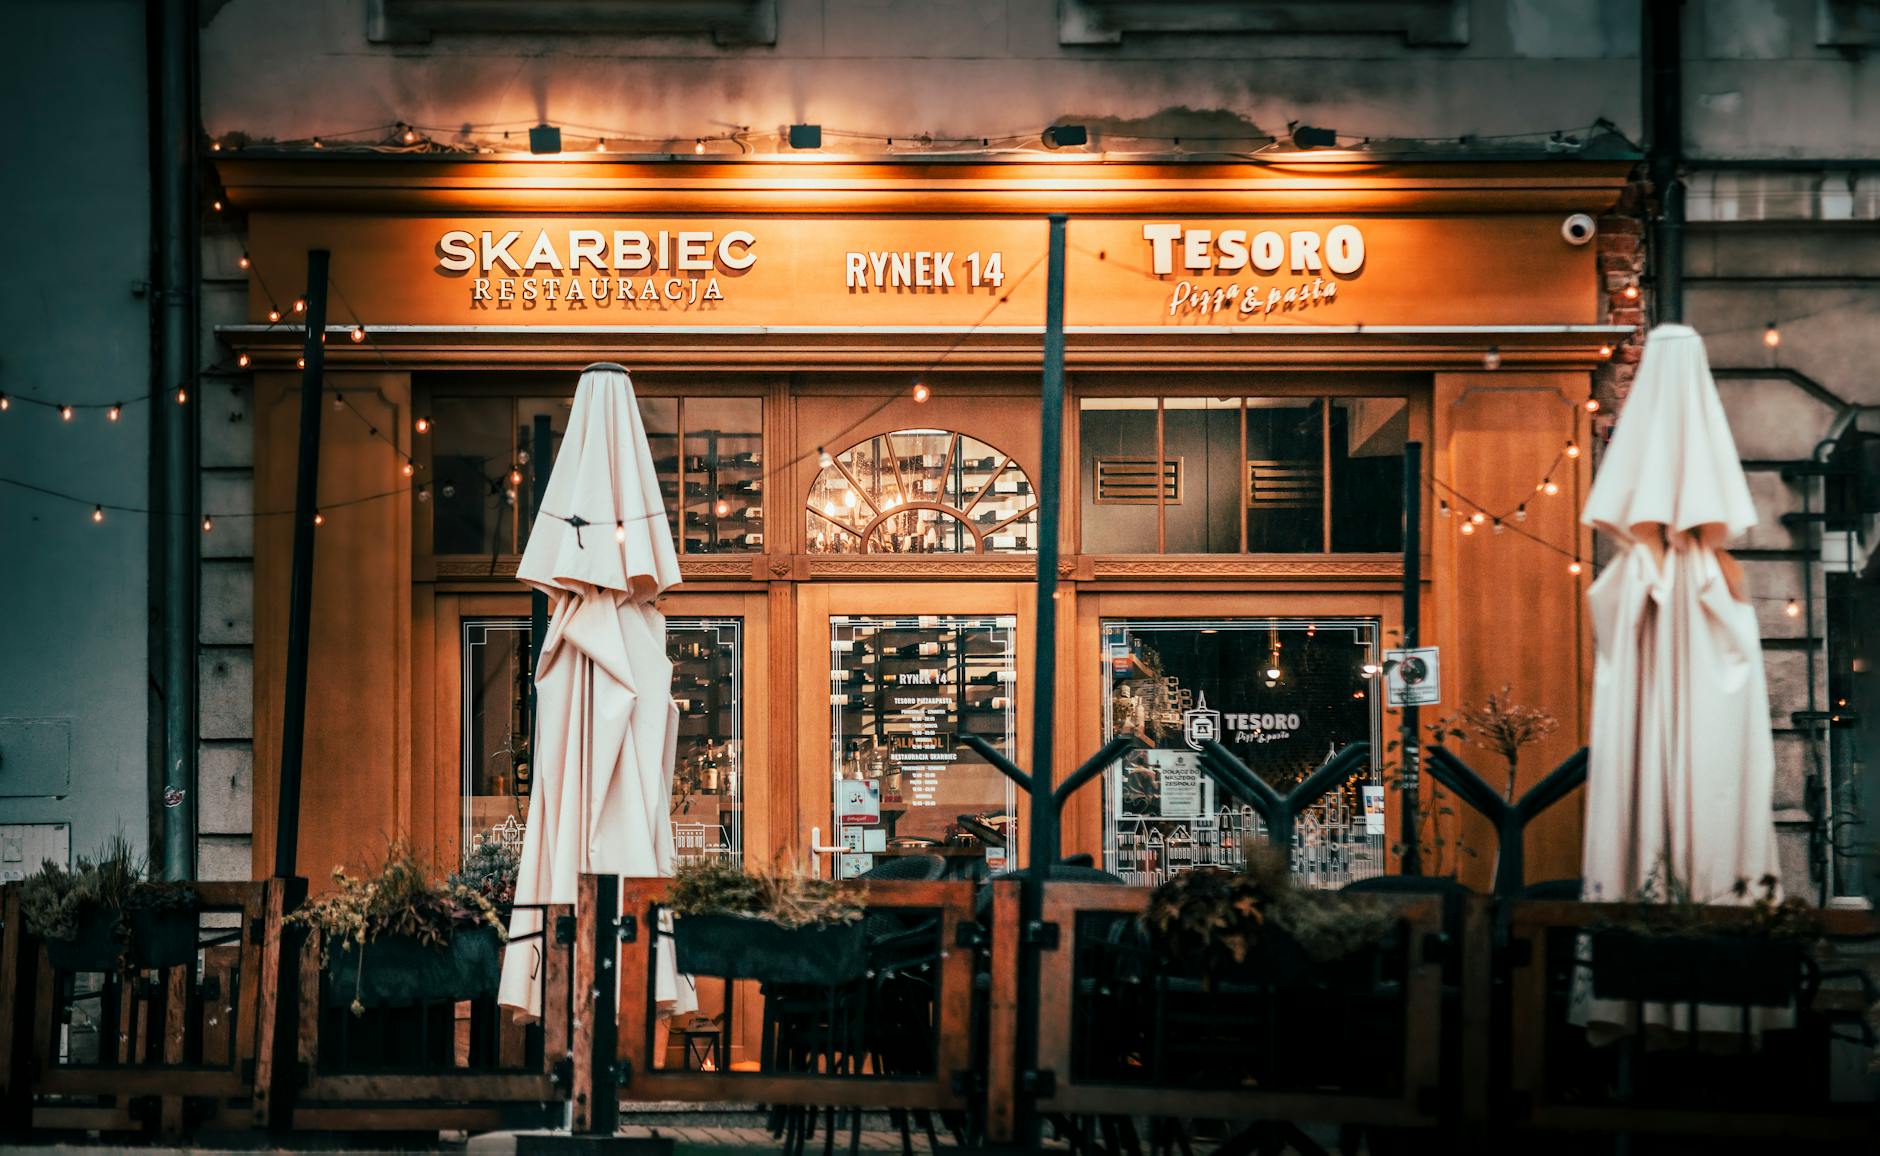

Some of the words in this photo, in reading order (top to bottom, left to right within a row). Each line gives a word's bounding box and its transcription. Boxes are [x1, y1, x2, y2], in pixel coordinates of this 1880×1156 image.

[439, 229, 758, 271] SKARBIEC
[1143, 223, 1365, 275] TESORO
[845, 251, 955, 287] RYNEK
[966, 251, 1006, 287] 14
[473, 277, 725, 304] RESTAURACJA
[1169, 280, 1241, 316] Pizza
[1240, 285, 1264, 313] &
[1265, 276, 1338, 313] pasta
[899, 673, 932, 685] RYNEK
[934, 672, 947, 685] 14
[1224, 713, 1301, 731] TESORO
[896, 737, 945, 749] ALKOL
